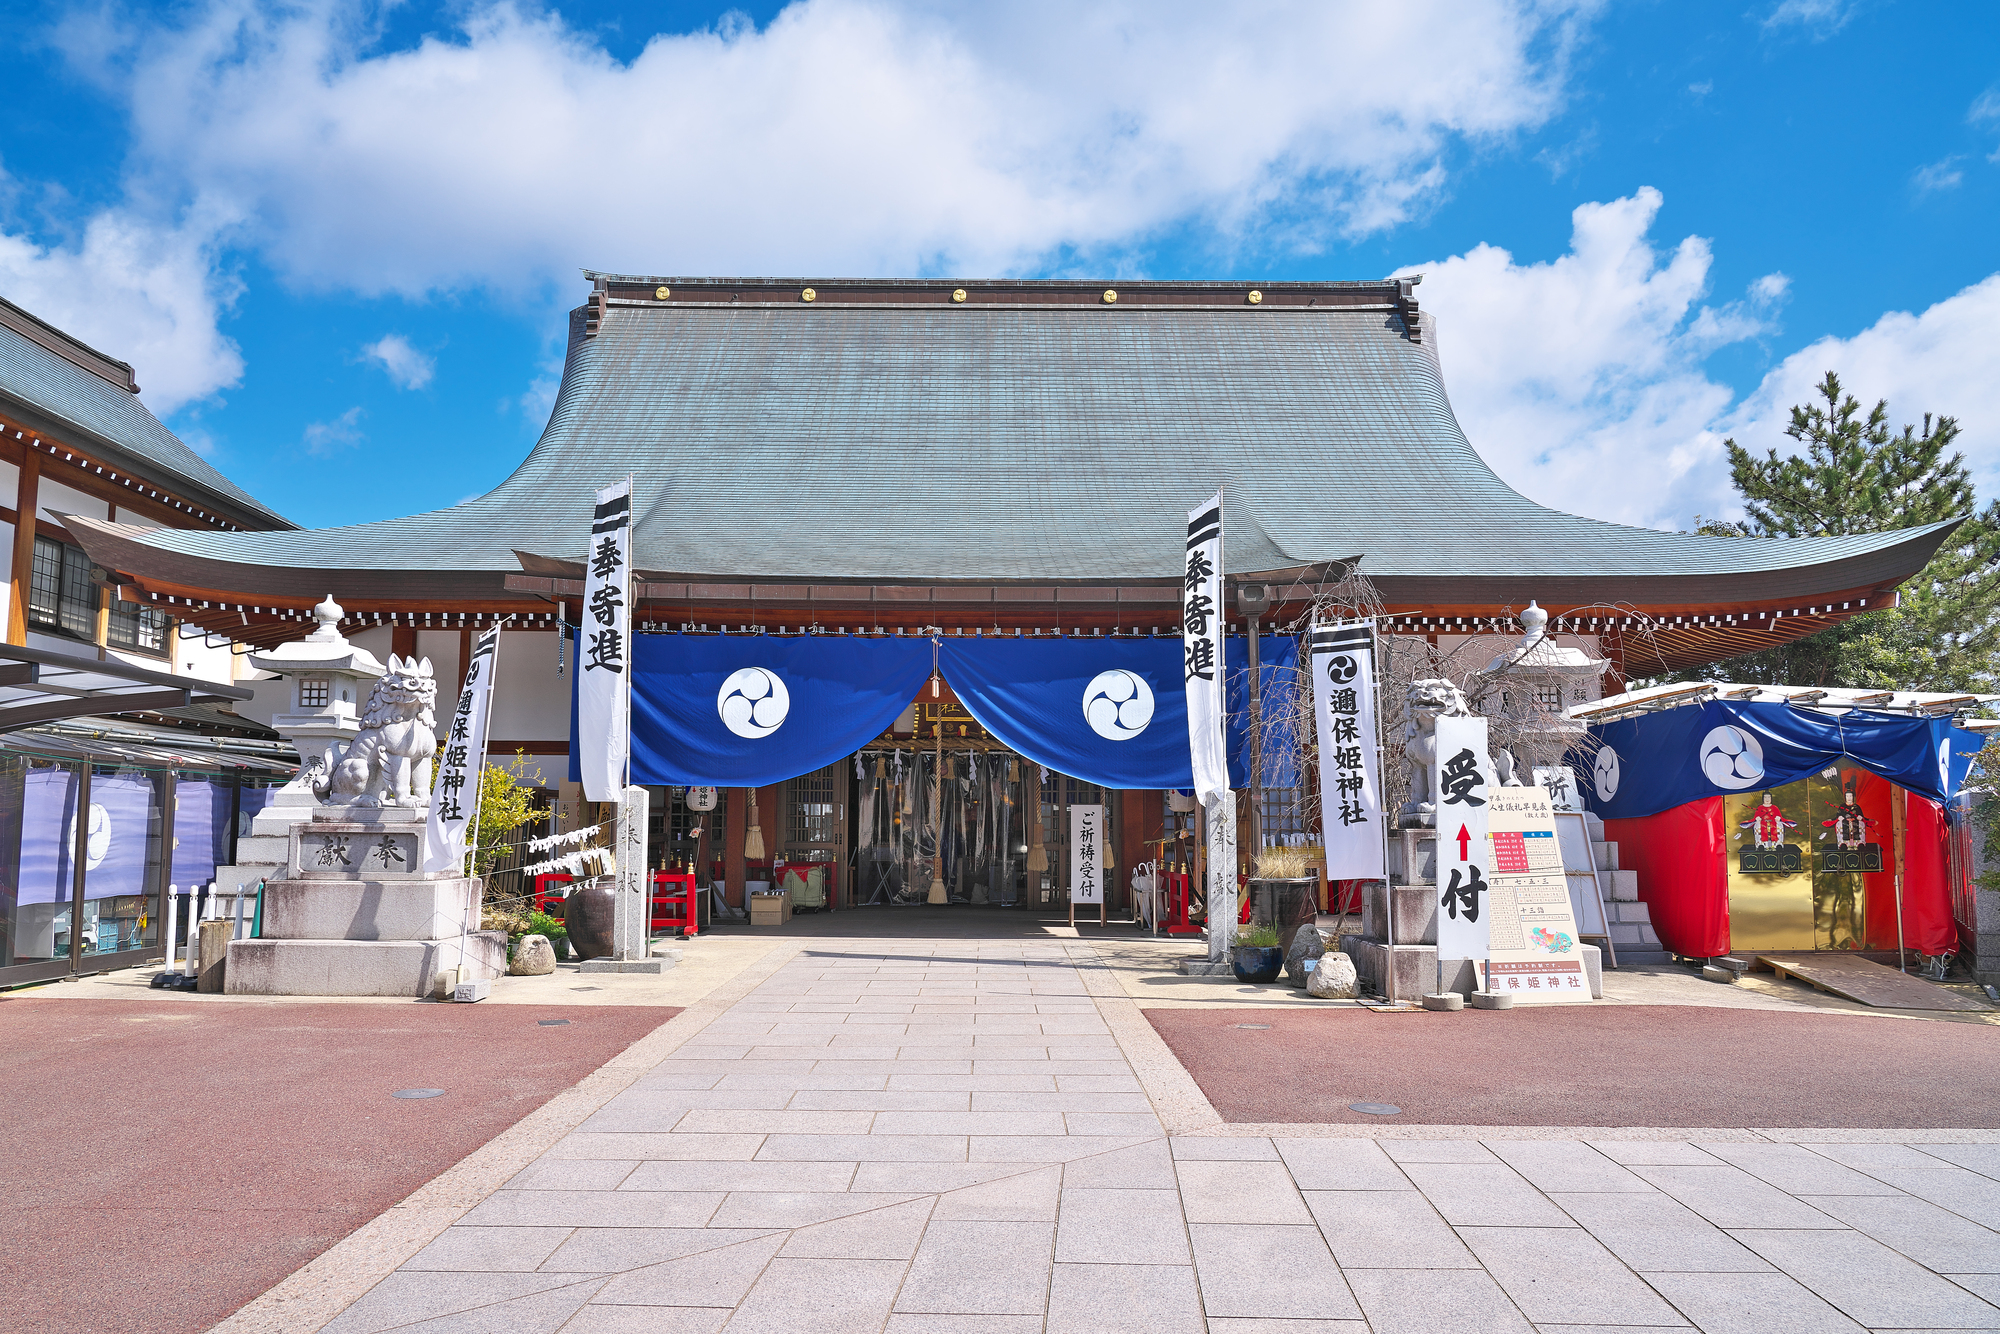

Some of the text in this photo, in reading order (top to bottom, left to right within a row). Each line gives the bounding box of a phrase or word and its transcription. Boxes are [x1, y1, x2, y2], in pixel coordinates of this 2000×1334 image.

[584, 536, 624, 674] 奉寄進
[1184, 550, 1215, 684] 奉寄進
[436, 688, 475, 824] 邇保姫神社
[1330, 687, 1369, 828] 邇保姫神社
[1079, 811, 1096, 898] ご祈祷受付
